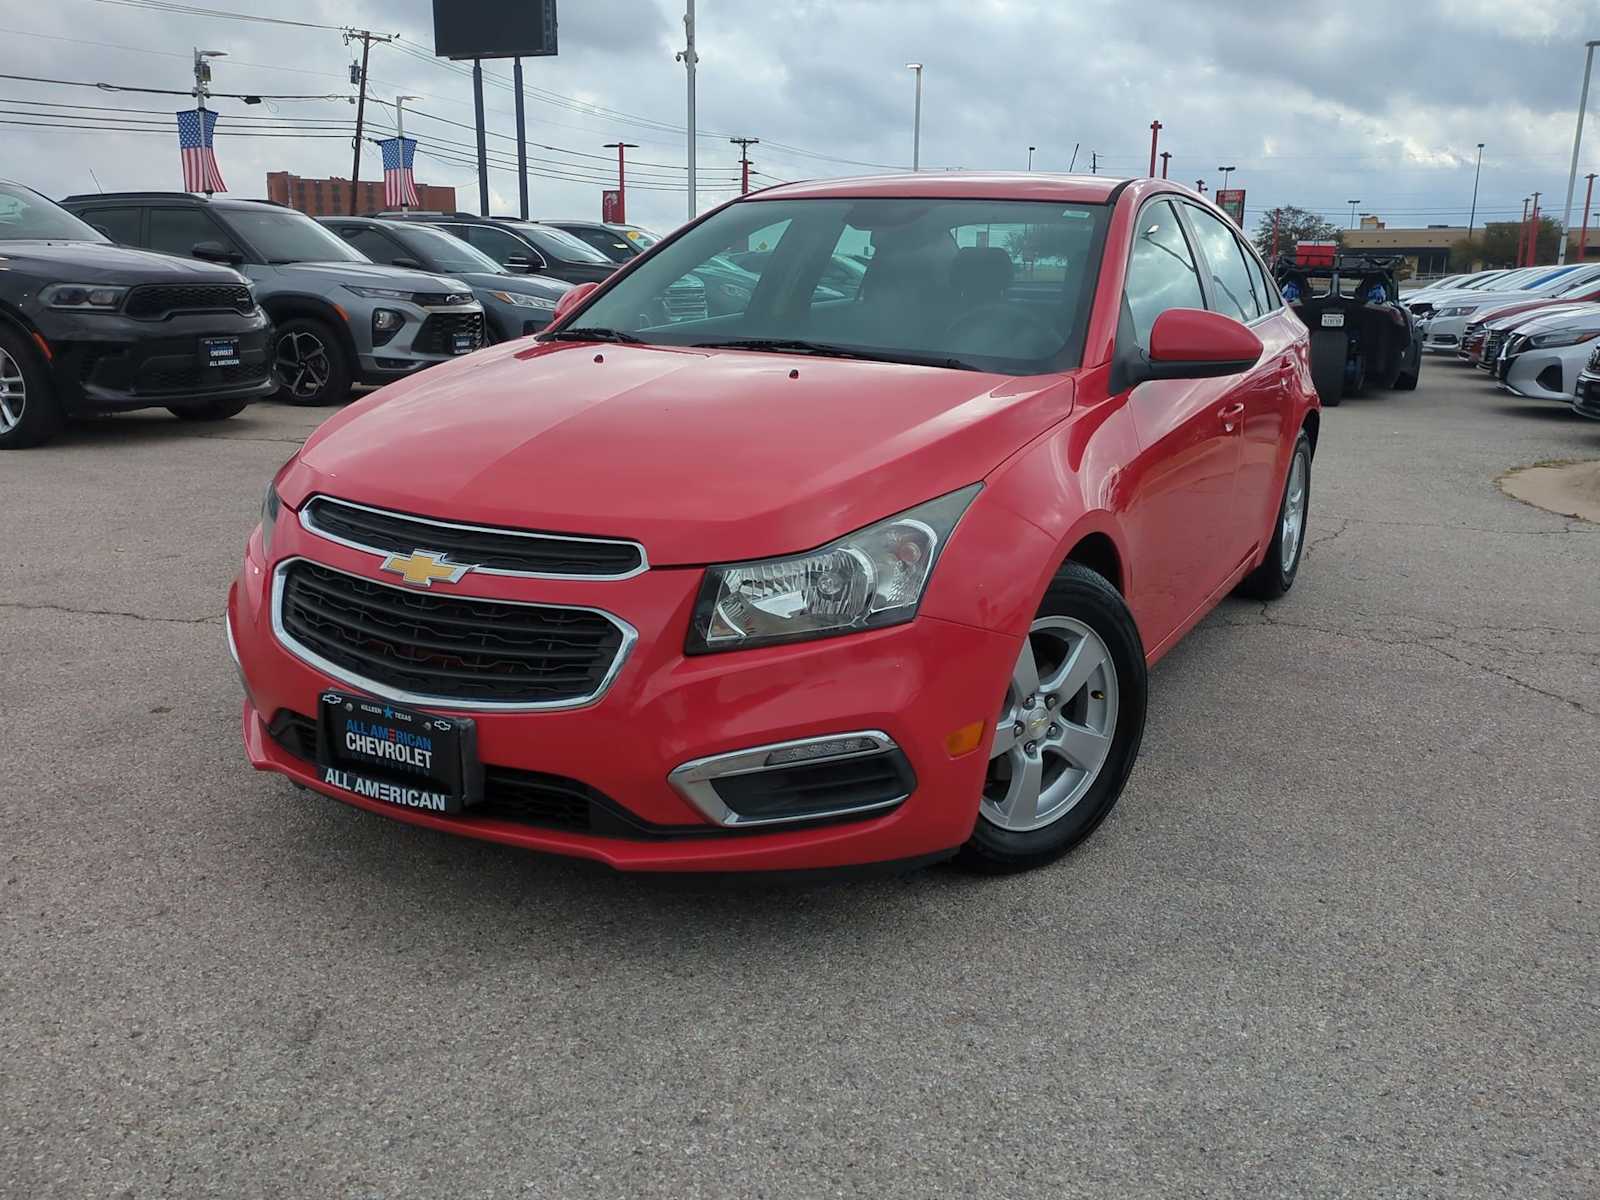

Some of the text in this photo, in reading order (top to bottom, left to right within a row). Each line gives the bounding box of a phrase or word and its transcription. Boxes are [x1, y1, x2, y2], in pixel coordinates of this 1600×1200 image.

[360, 704, 412, 722] KILLEEN TEXAS
[345, 719, 432, 750] ALL AMERICAN
[345, 732, 432, 769] CHEVROLET
[325, 768, 446, 811] ALL AMERICAN
